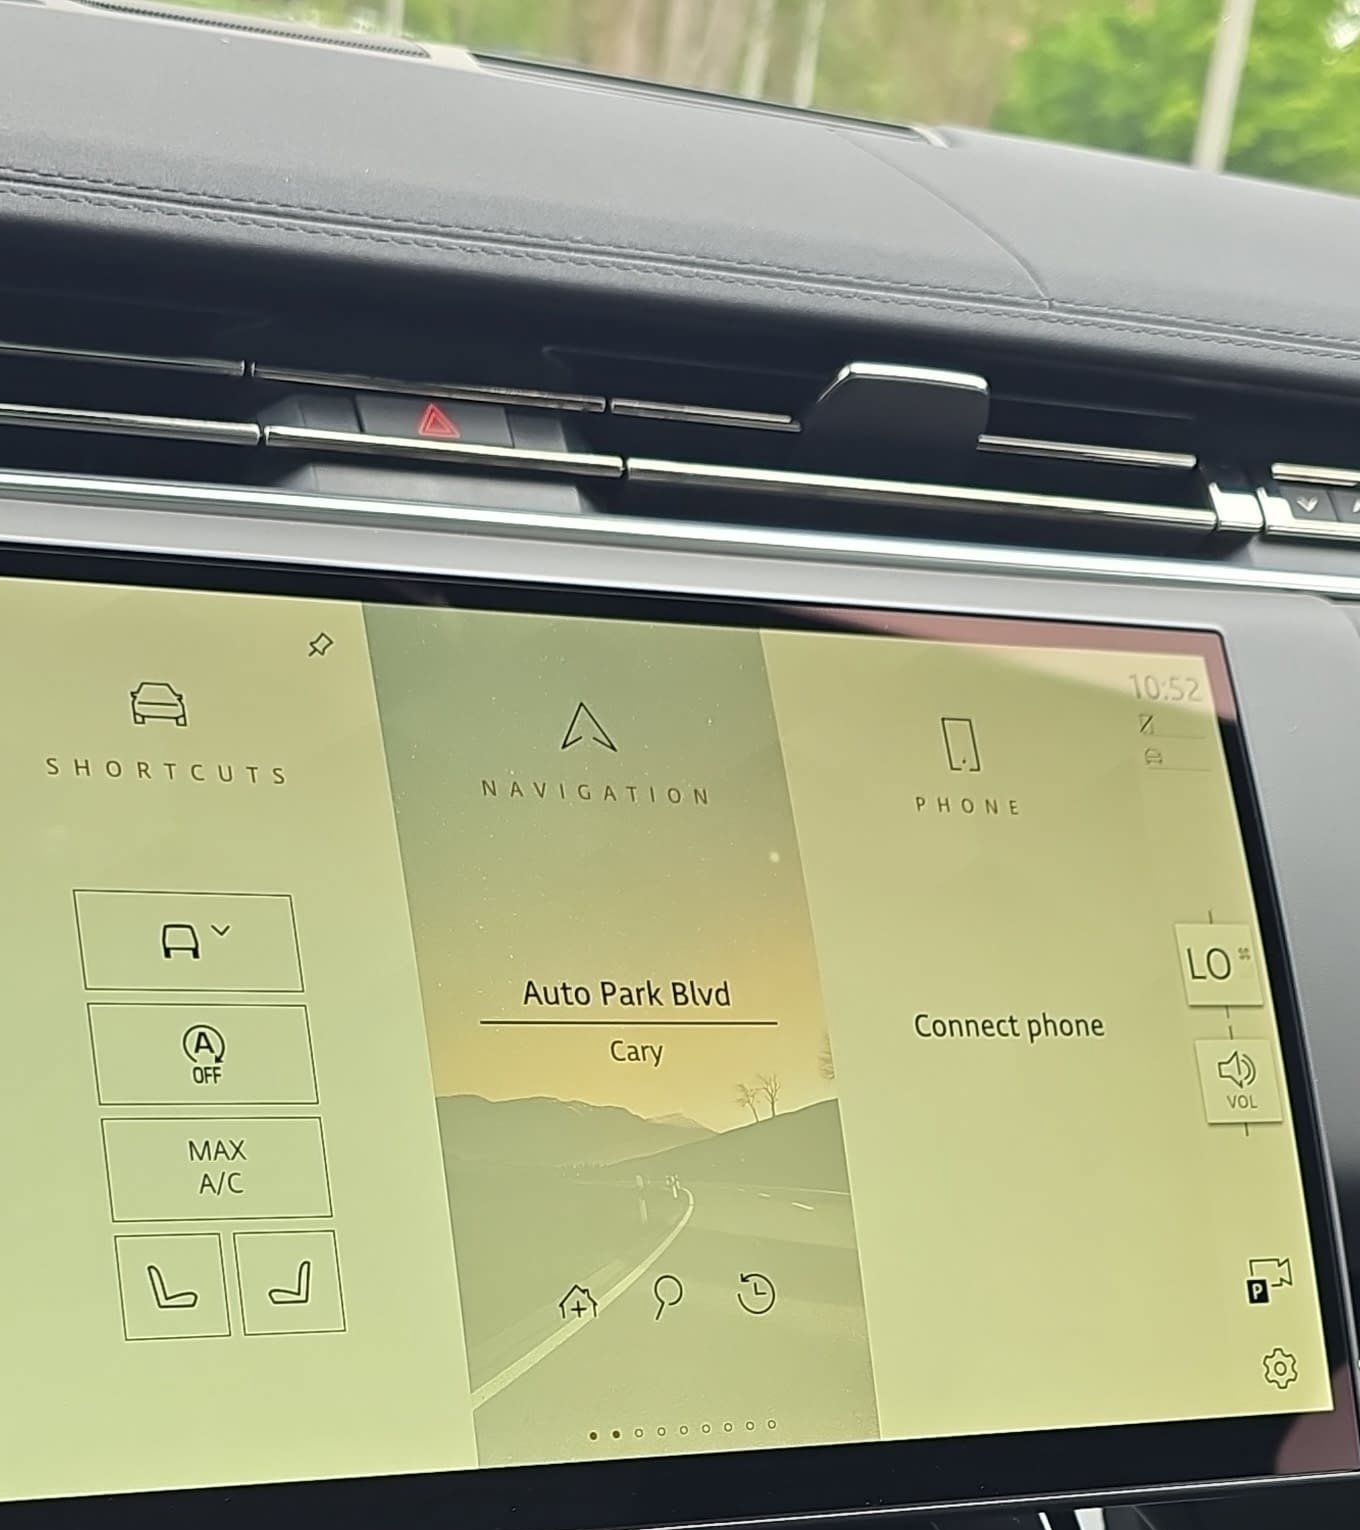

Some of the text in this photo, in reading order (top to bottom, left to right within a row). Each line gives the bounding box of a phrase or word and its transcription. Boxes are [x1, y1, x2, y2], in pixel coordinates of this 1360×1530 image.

[1128, 673, 1203, 702] 10:52
[46, 757, 286, 786] SHORTCUTS
[481, 779, 709, 806] NAVIGATION
[915, 796, 1019, 817] PHONE
[1187, 948, 1232, 981] LO
[523, 980, 731, 1008] Auto Park Blvd
[914, 1012, 1105, 1044] Connect phone
[194, 1032, 214, 1054] A
[610, 1041, 663, 1068] Cary
[192, 1066, 222, 1084] OFF
[1227, 1095, 1258, 1110] VOL
[188, 1140, 247, 1162] MAX
[199, 1172, 244, 1196] A/C
